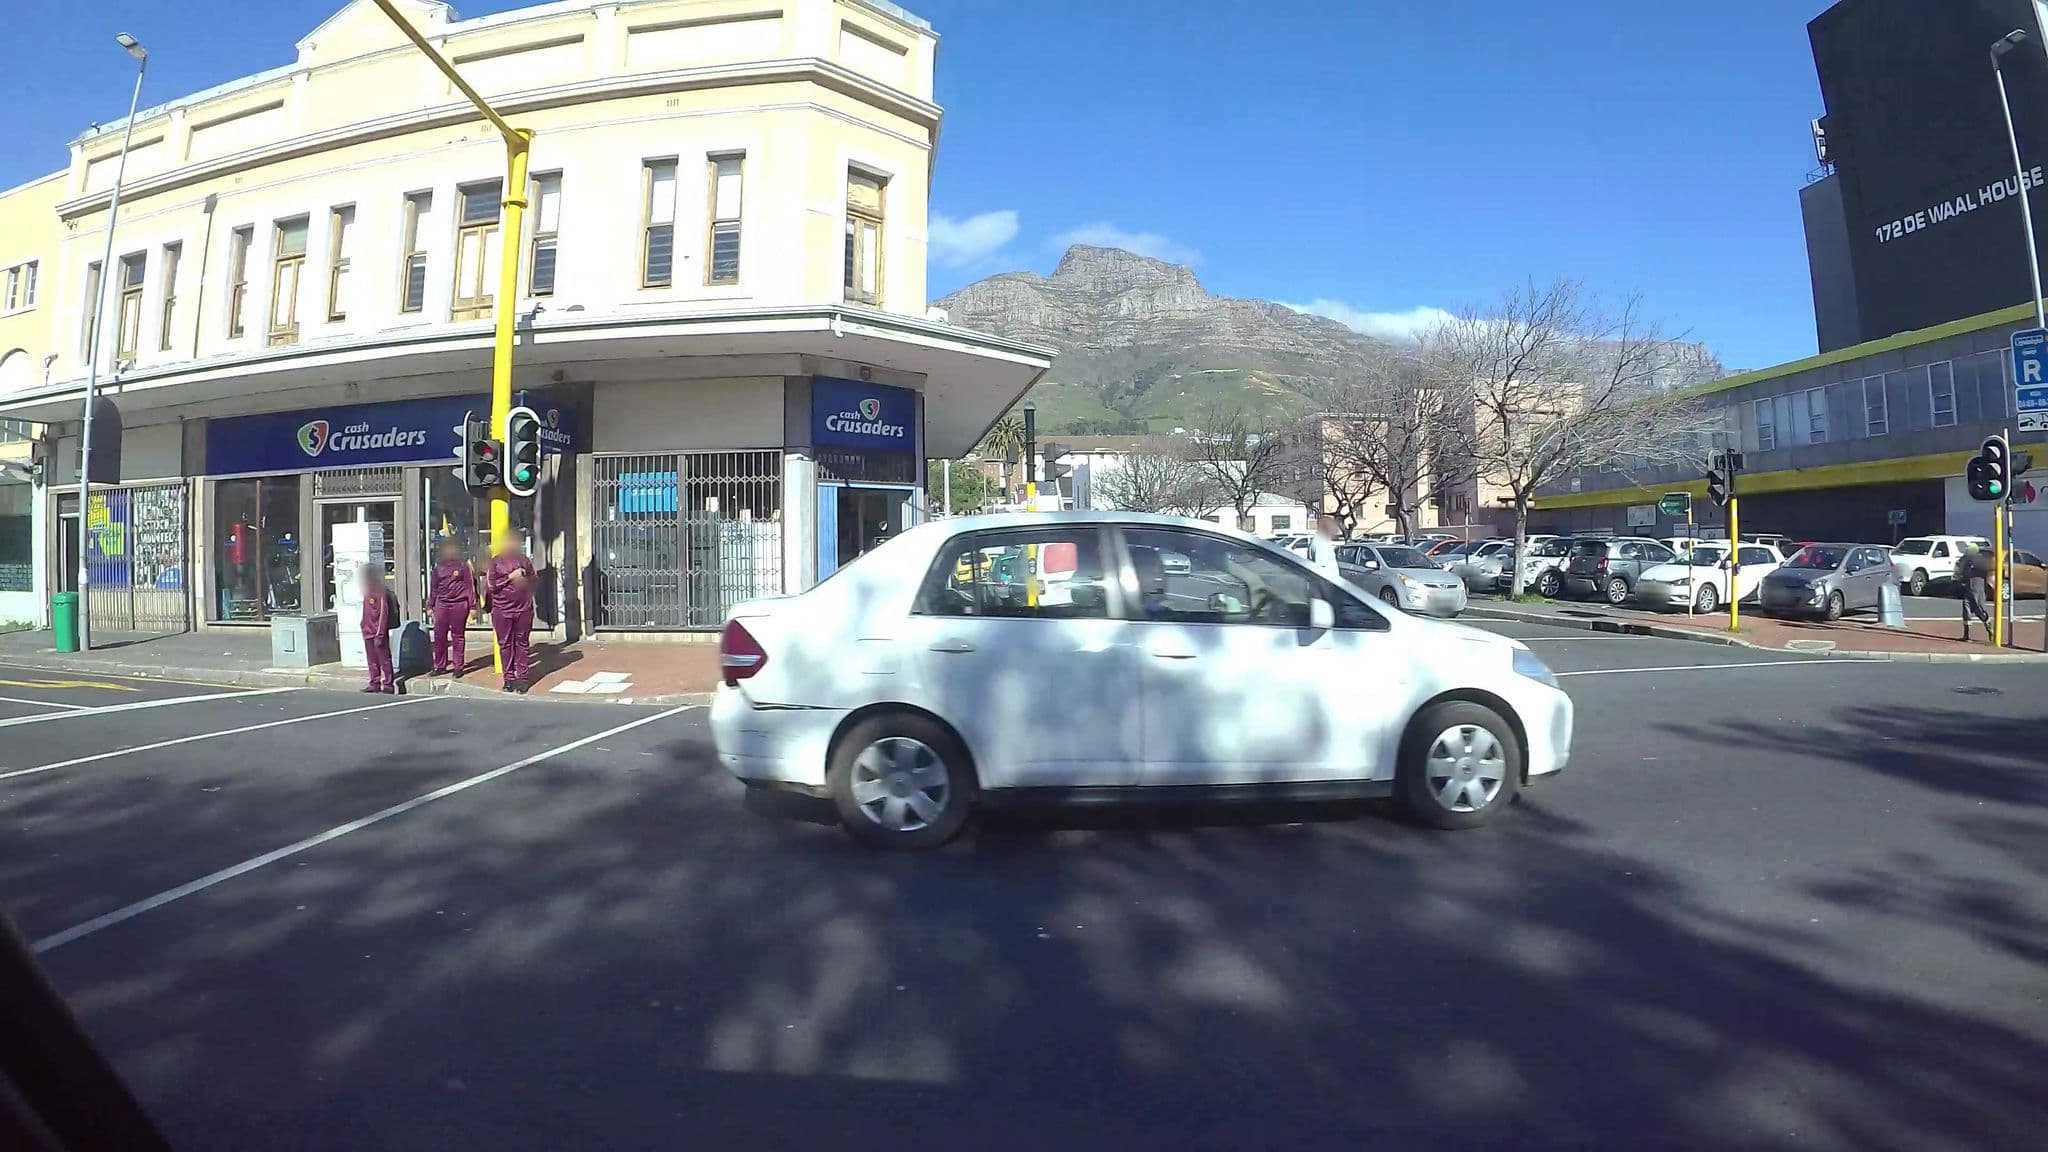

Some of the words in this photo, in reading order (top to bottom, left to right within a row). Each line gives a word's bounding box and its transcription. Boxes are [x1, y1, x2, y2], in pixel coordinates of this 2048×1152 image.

[1875, 220, 1903, 243] 172
[1904, 211, 1927, 234] DE
[1928, 194, 1977, 224] WAAL
[1978, 166, 2044, 206] HOUSE
[2023, 359, 2042, 382] R
[826, 414, 904, 437] Crusaders
[840, 410, 861, 420] cash
[329, 427, 426, 451] Crusaders
[344, 421, 369, 434] cash
